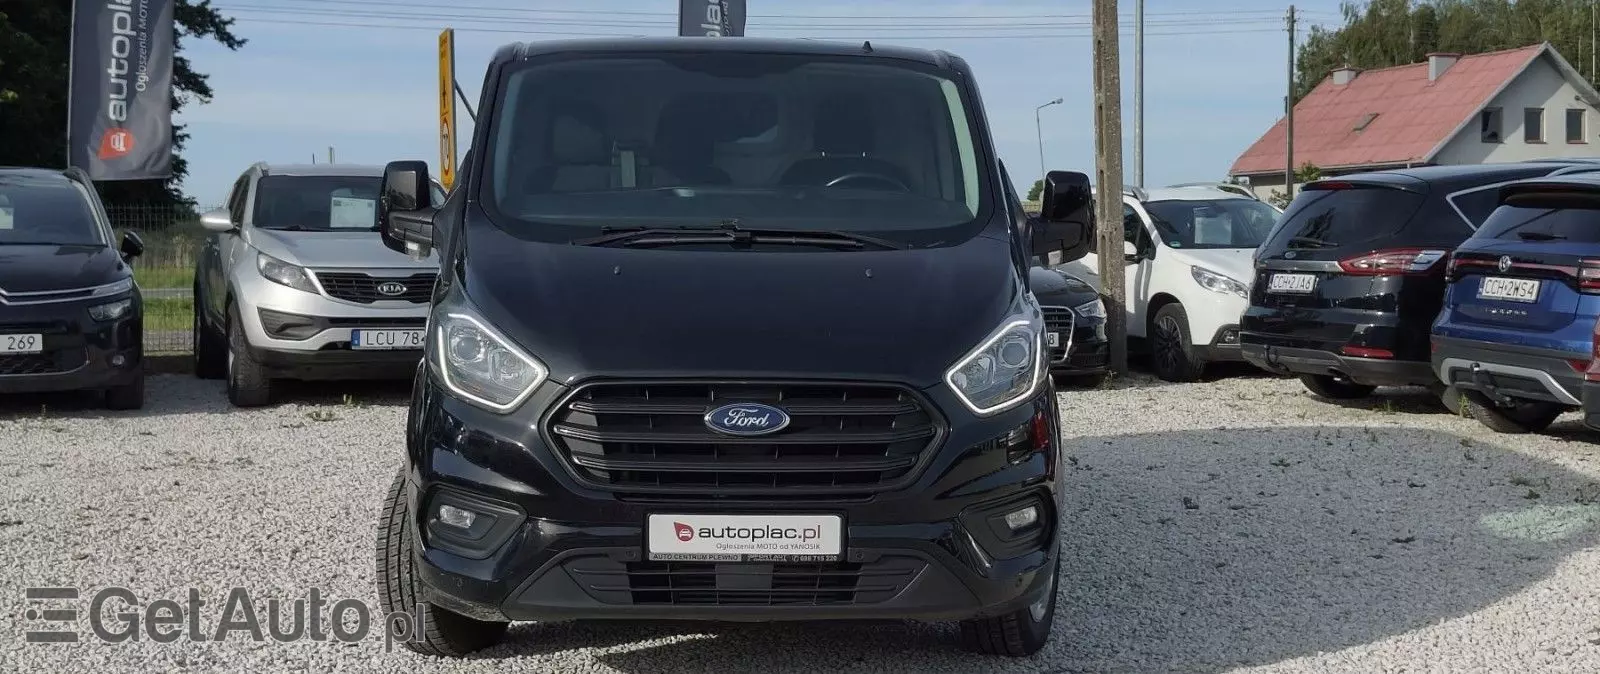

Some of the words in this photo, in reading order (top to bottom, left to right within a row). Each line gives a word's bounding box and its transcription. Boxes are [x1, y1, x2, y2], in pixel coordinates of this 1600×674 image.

[107, 0, 137, 121] autopl
[1485, 279, 1505, 295] CCH
[1506, 281, 1535, 298] 2WS4
[8, 336, 35, 350] 269
[366, 332, 395, 345] LCU
[402, 332, 425, 345] 78
[724, 408, 770, 427] Ford
[698, 524, 821, 543] autoplac.pl
